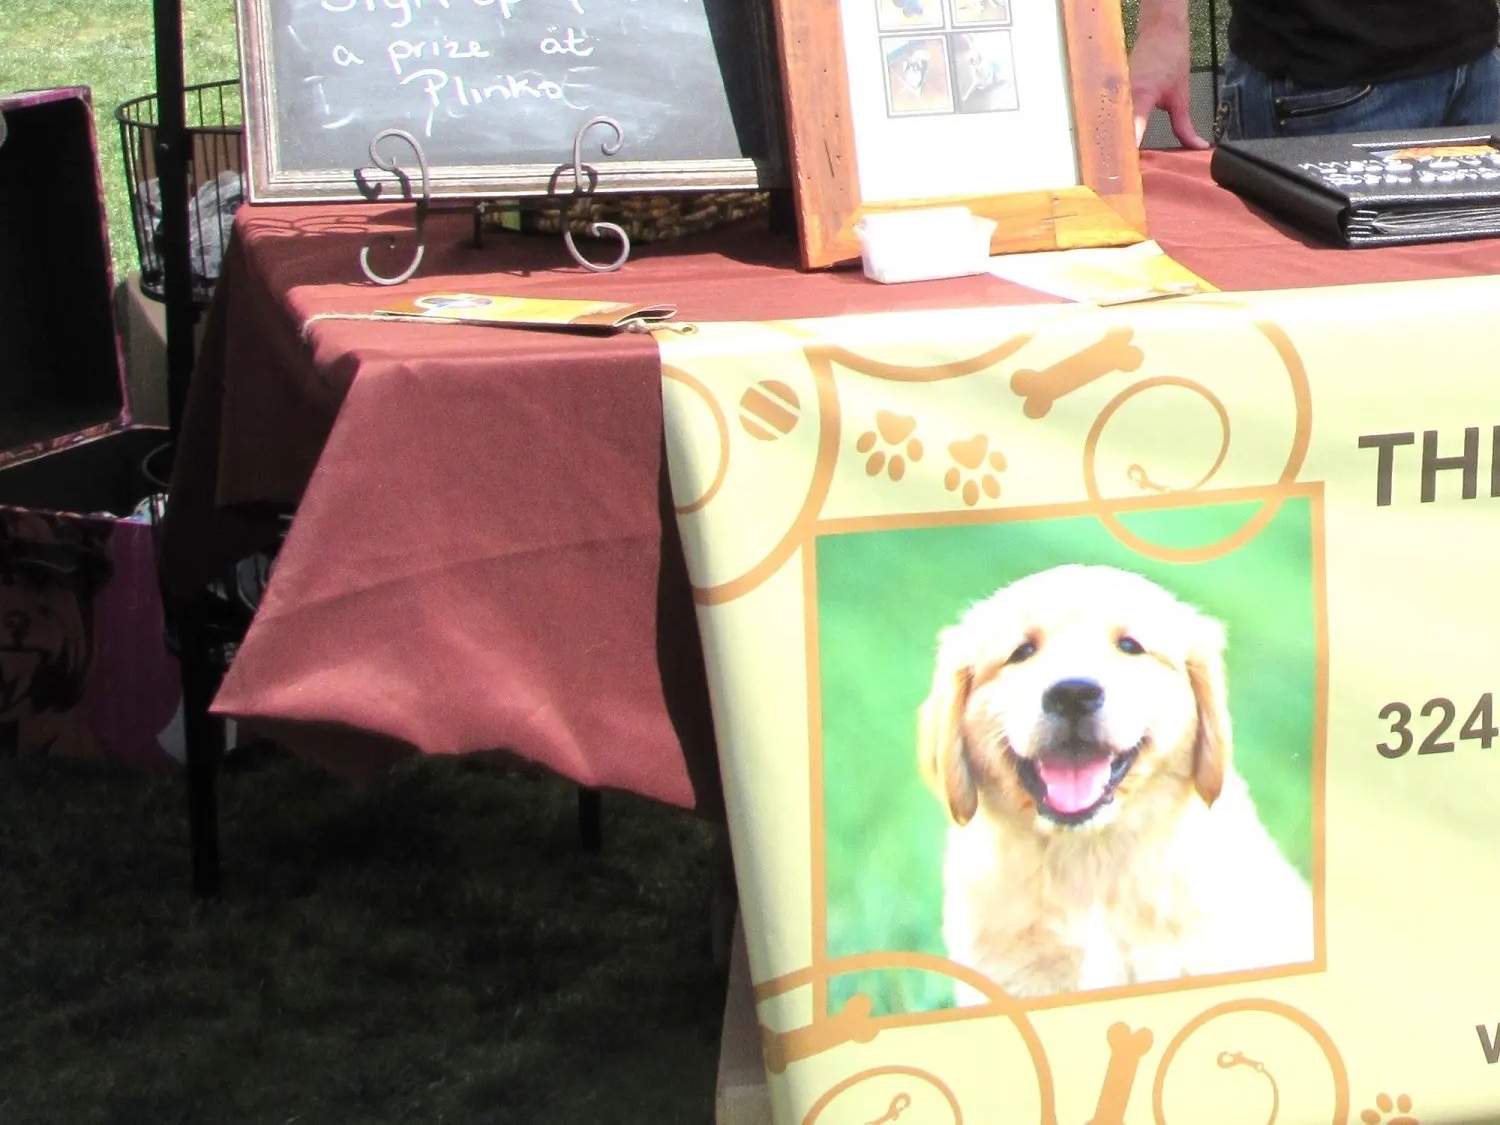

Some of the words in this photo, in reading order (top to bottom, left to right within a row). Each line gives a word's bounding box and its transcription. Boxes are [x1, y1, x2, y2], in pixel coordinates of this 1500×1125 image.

[333, 43, 364, 65] a
[387, 37, 489, 74] prize
[540, 32, 594, 56] at
